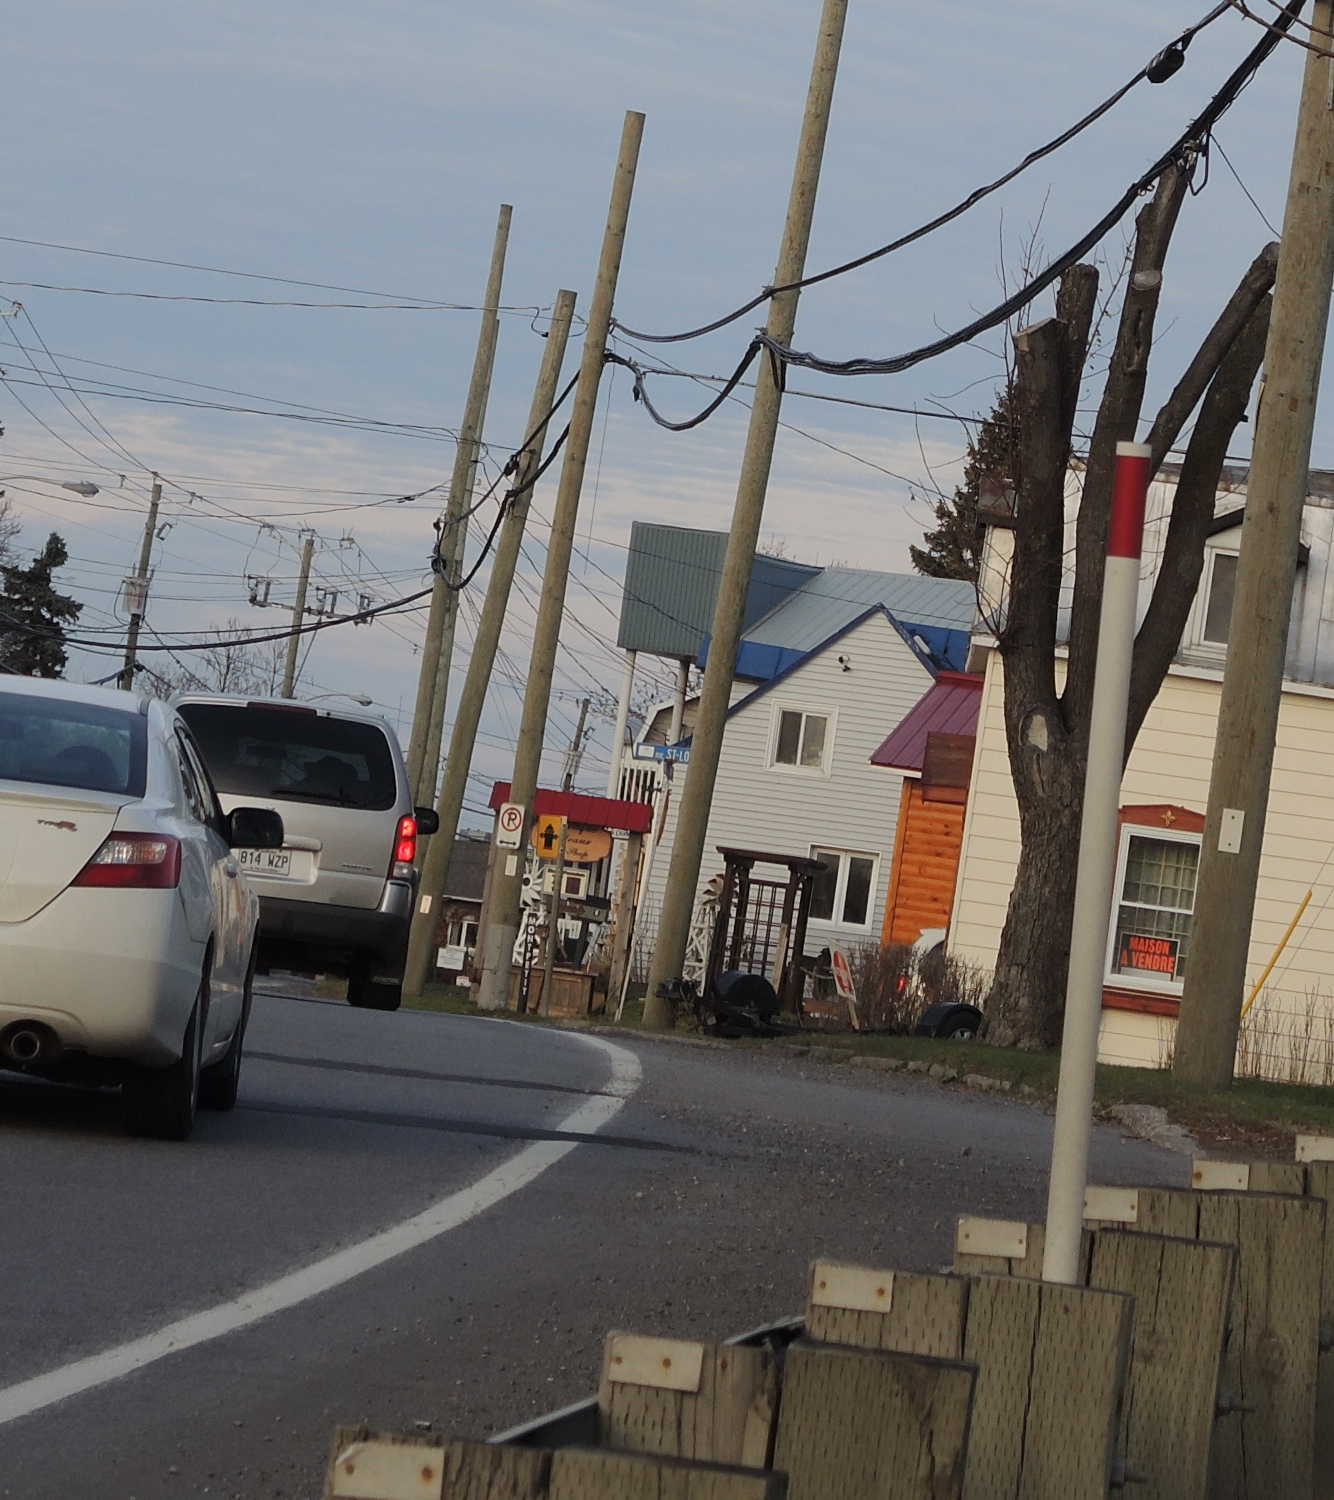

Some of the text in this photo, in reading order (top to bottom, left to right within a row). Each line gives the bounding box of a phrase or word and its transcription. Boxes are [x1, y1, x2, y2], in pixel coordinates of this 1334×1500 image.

[240, 850, 289, 869] 814 WZP
[1129, 936, 1171, 955] MAISON
[1132, 951, 1175, 973] VENDRE
